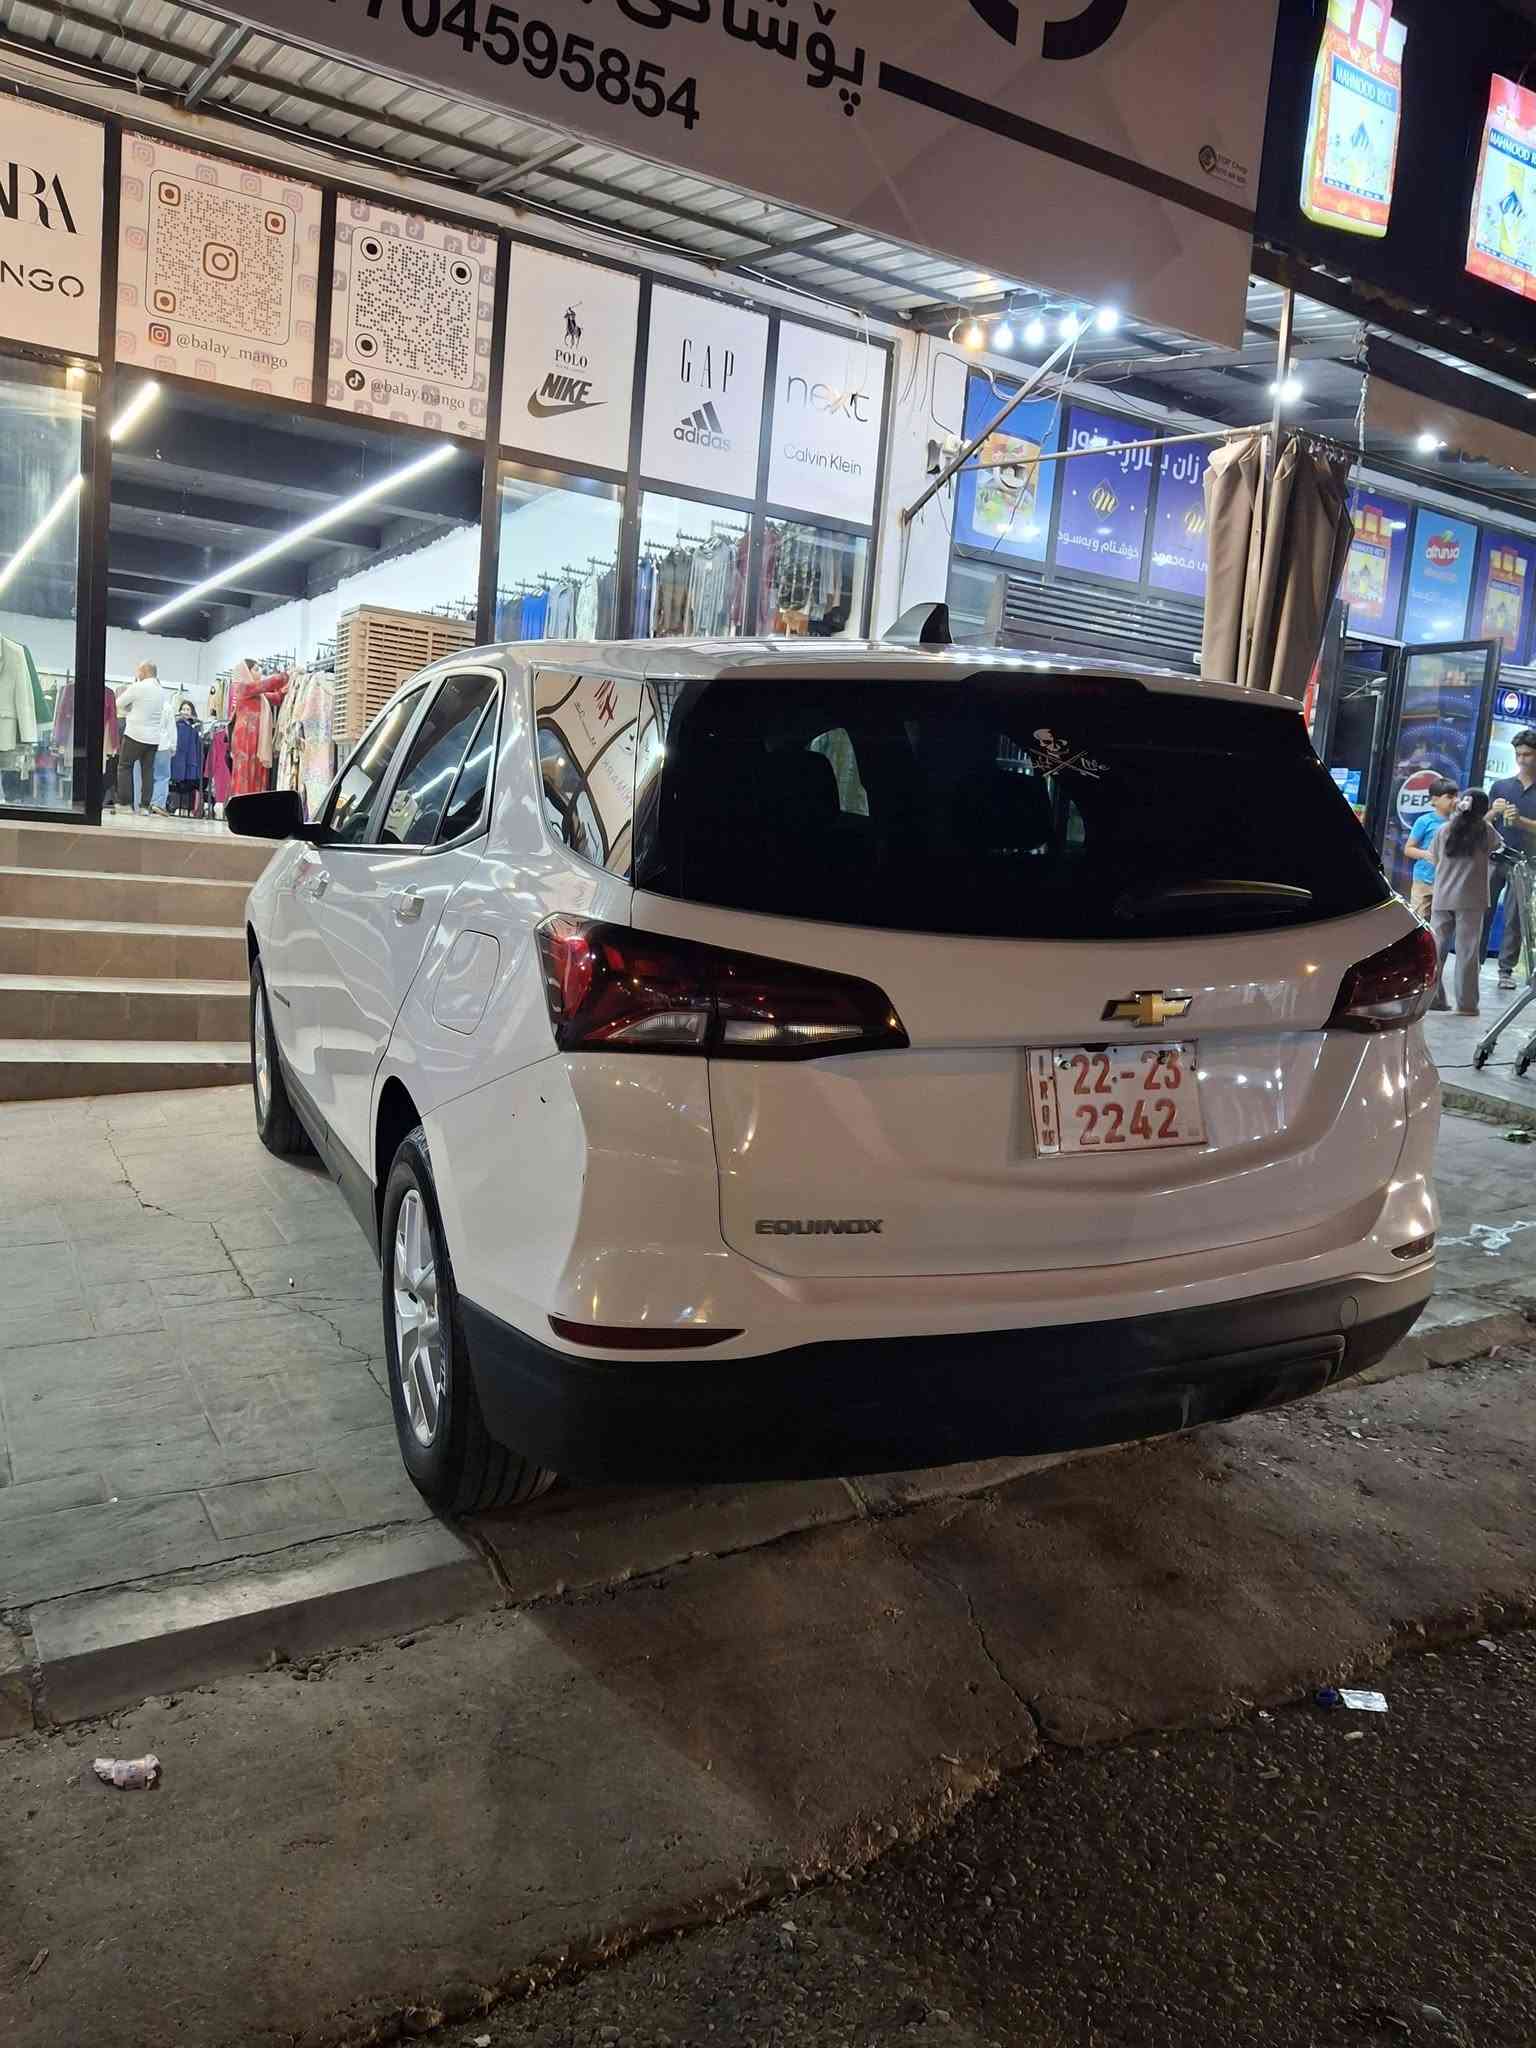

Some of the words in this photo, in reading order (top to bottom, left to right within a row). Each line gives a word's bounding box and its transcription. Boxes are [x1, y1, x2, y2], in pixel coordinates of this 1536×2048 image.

[176, 333, 288, 369] @balay_mango
[555, 349, 588, 368] POLO
[680, 338, 735, 392] GAP
[540, 372, 592, 405] NIKE
[786, 376, 870, 423] next
[673, 426, 732, 452] adidas
[783, 443, 828, 468] Calvin
[829, 454, 862, 475] Klein
[1400, 794, 1431, 806] PEP
[1072, 1050, 1182, 1094] 22-23
[1075, 1098, 1179, 1146] 2242
[755, 1219, 883, 1235] EQUINOX
